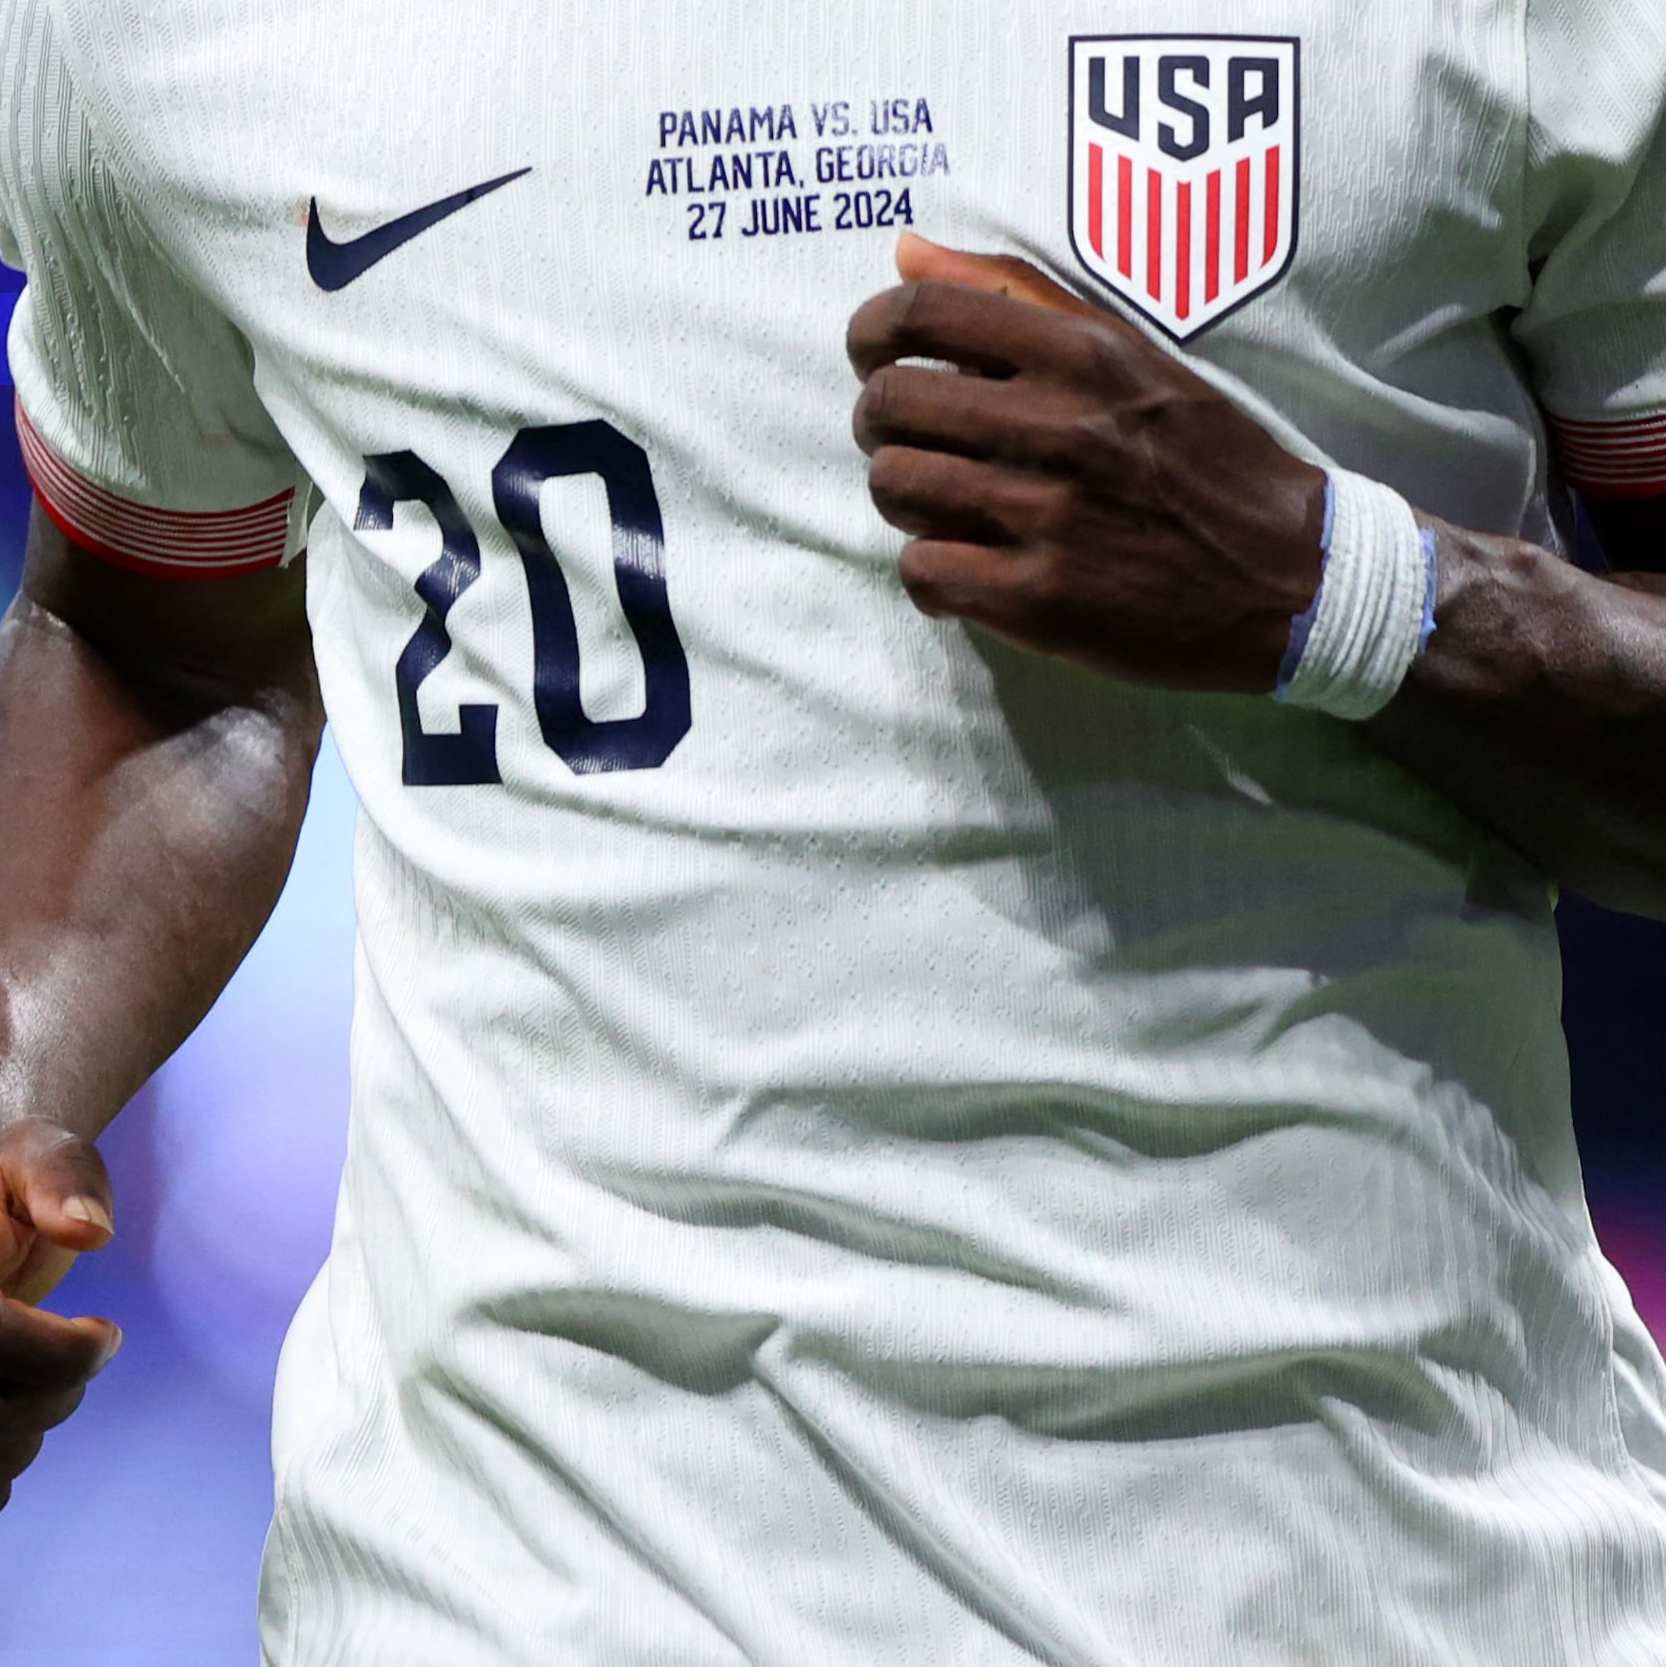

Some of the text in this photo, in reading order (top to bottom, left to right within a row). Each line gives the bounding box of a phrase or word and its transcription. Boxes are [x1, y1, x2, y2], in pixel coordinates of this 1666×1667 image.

[658, 97, 934, 148] PANAMA VS. USA
[1088, 54, 1280, 163] USA
[645, 142, 951, 197] ATLANTA, GEORGIA
[686, 187, 914, 241] 27 JUNE 2024
[352, 418, 693, 787] 20
